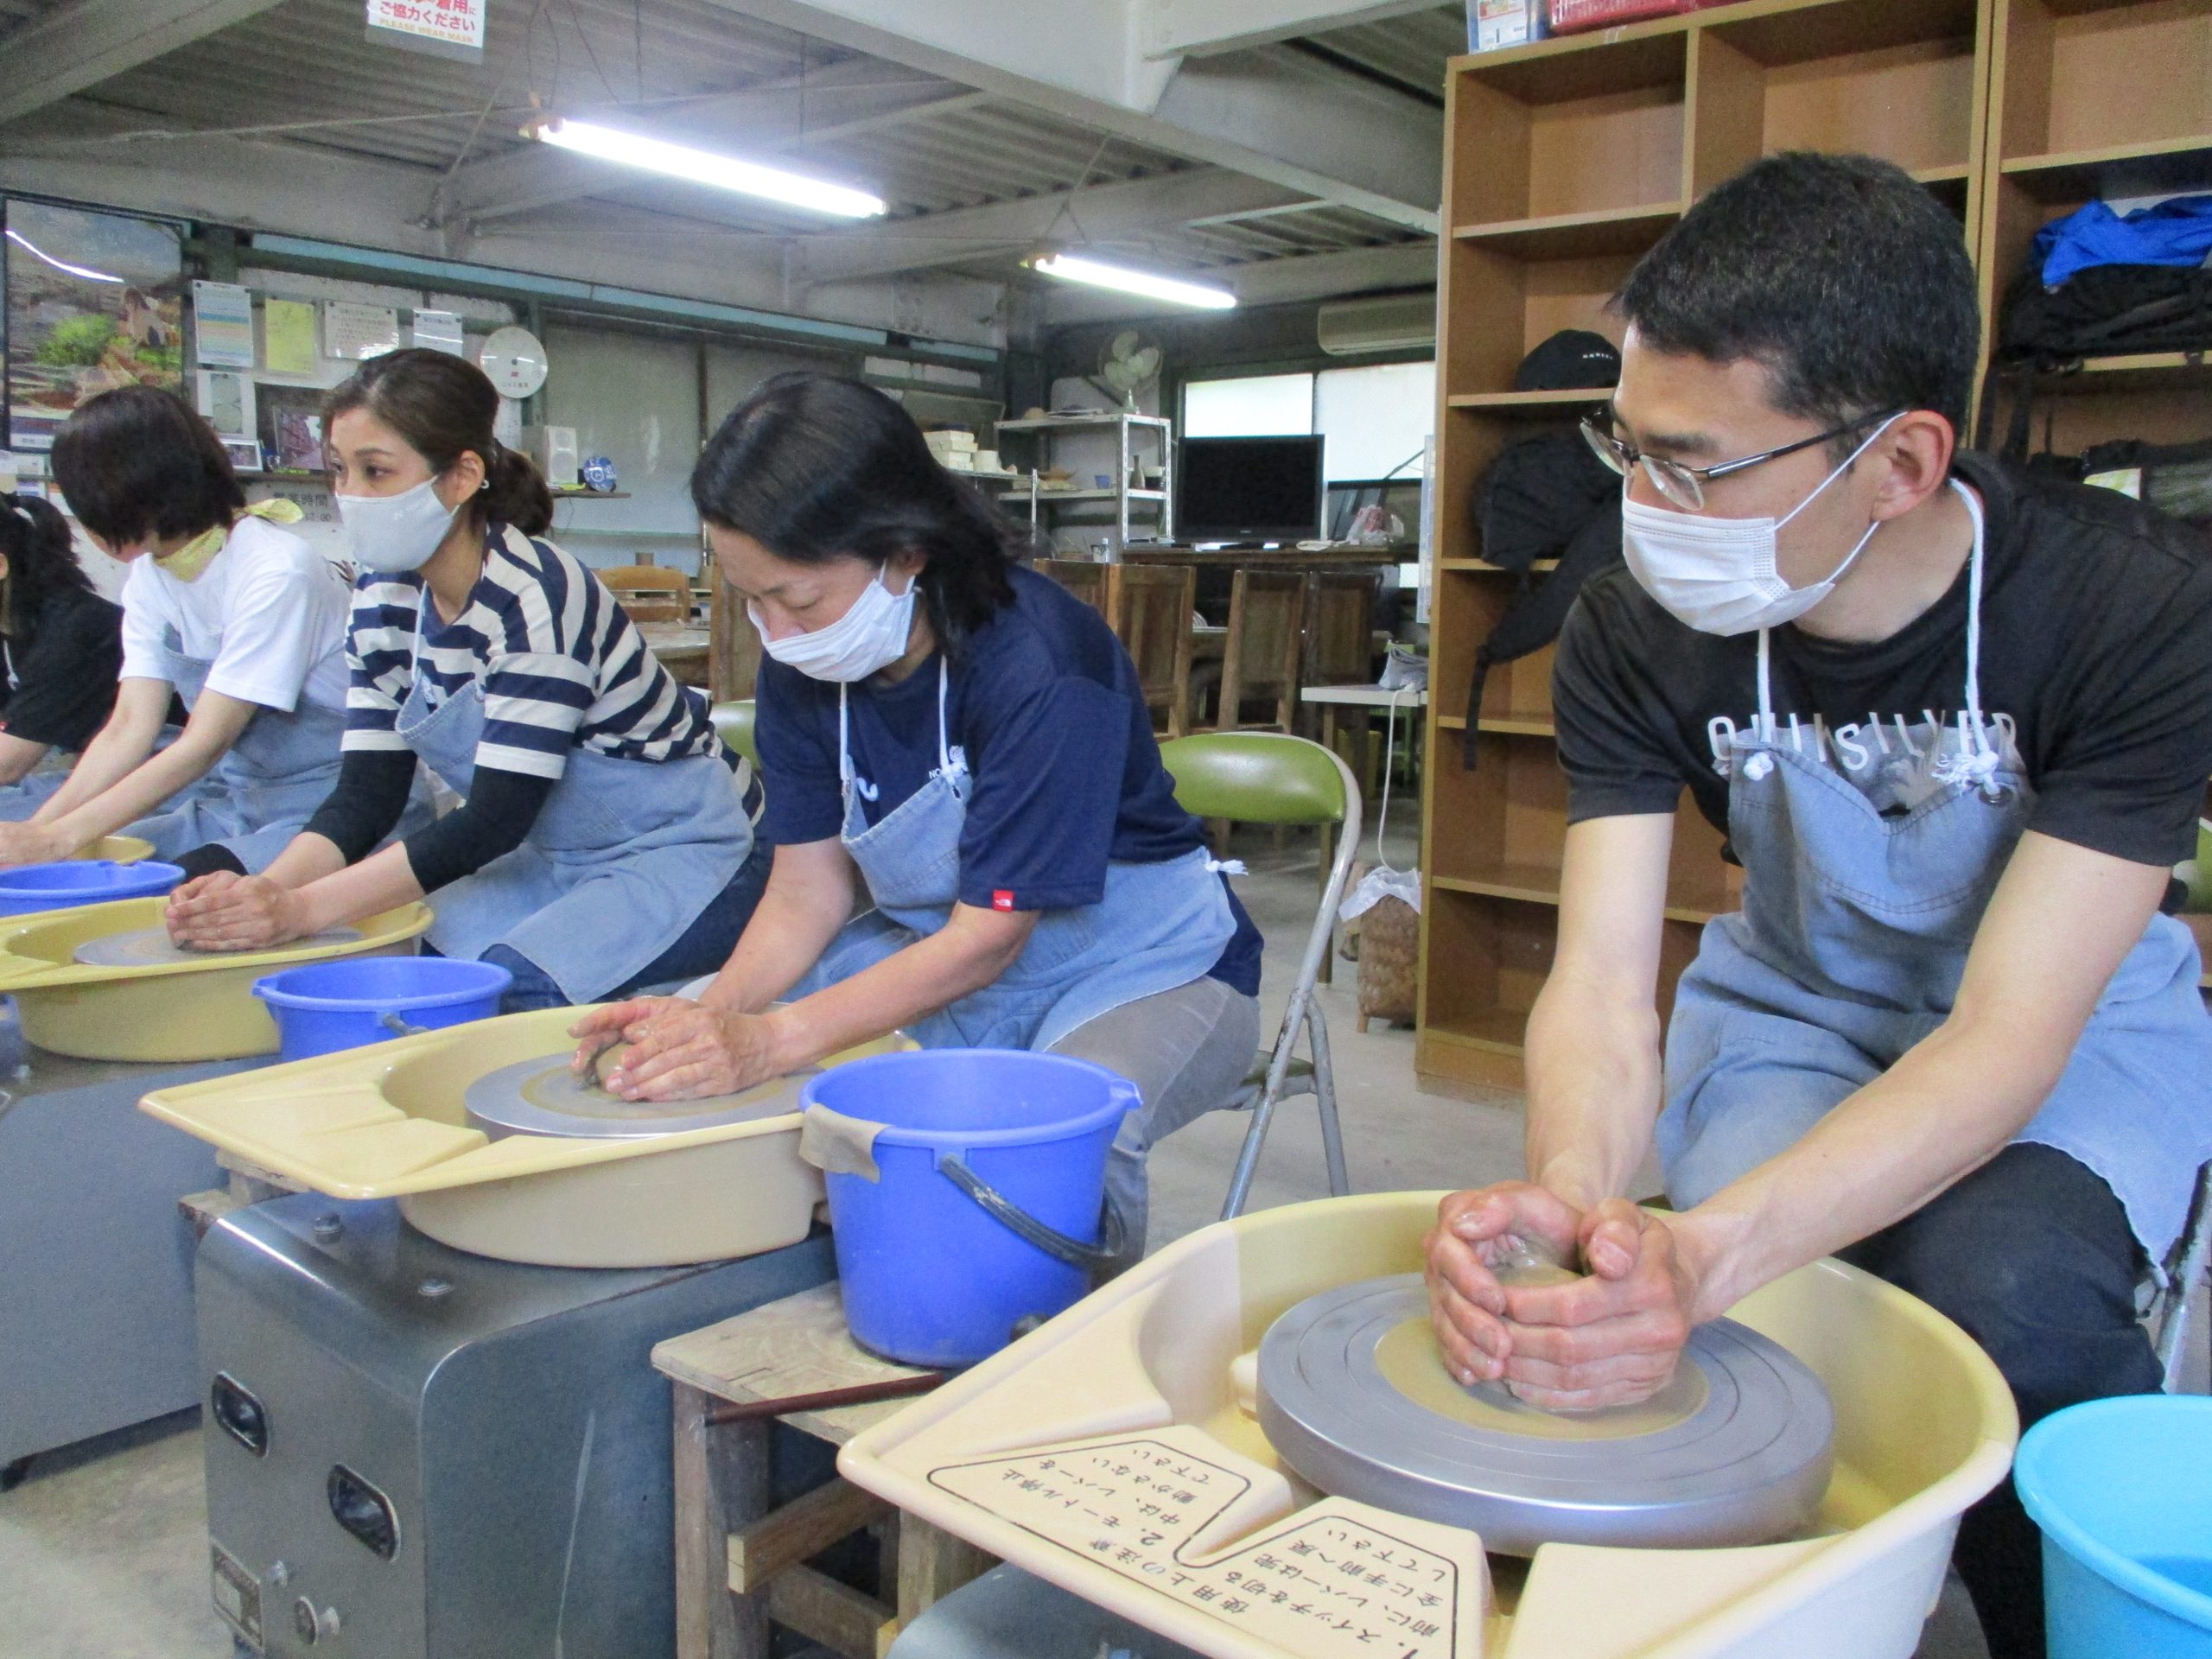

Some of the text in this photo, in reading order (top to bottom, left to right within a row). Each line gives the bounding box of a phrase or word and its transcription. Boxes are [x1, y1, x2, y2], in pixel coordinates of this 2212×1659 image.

[379, 18, 474, 43] PLEASE WEAR MASK
[380, 1, 475, 30] ご協力ください
[1040, 1459, 1180, 1525] 中は、レバーを
[1093, 1458, 1198, 1503] 動かさない
[1134, 1450, 1209, 1484] で下さい
[1002, 1468, 1165, 1546] 2. モートル停止
[1089, 1537, 1249, 1614] 使用上の注意
[1288, 1540, 1443, 1607] 全に手前へ戻
[1328, 1529, 1446, 1581] して下さい
[1226, 1571, 1382, 1643] スイッチを切る
[1254, 1553, 1440, 1637] 前に、レバーは完
